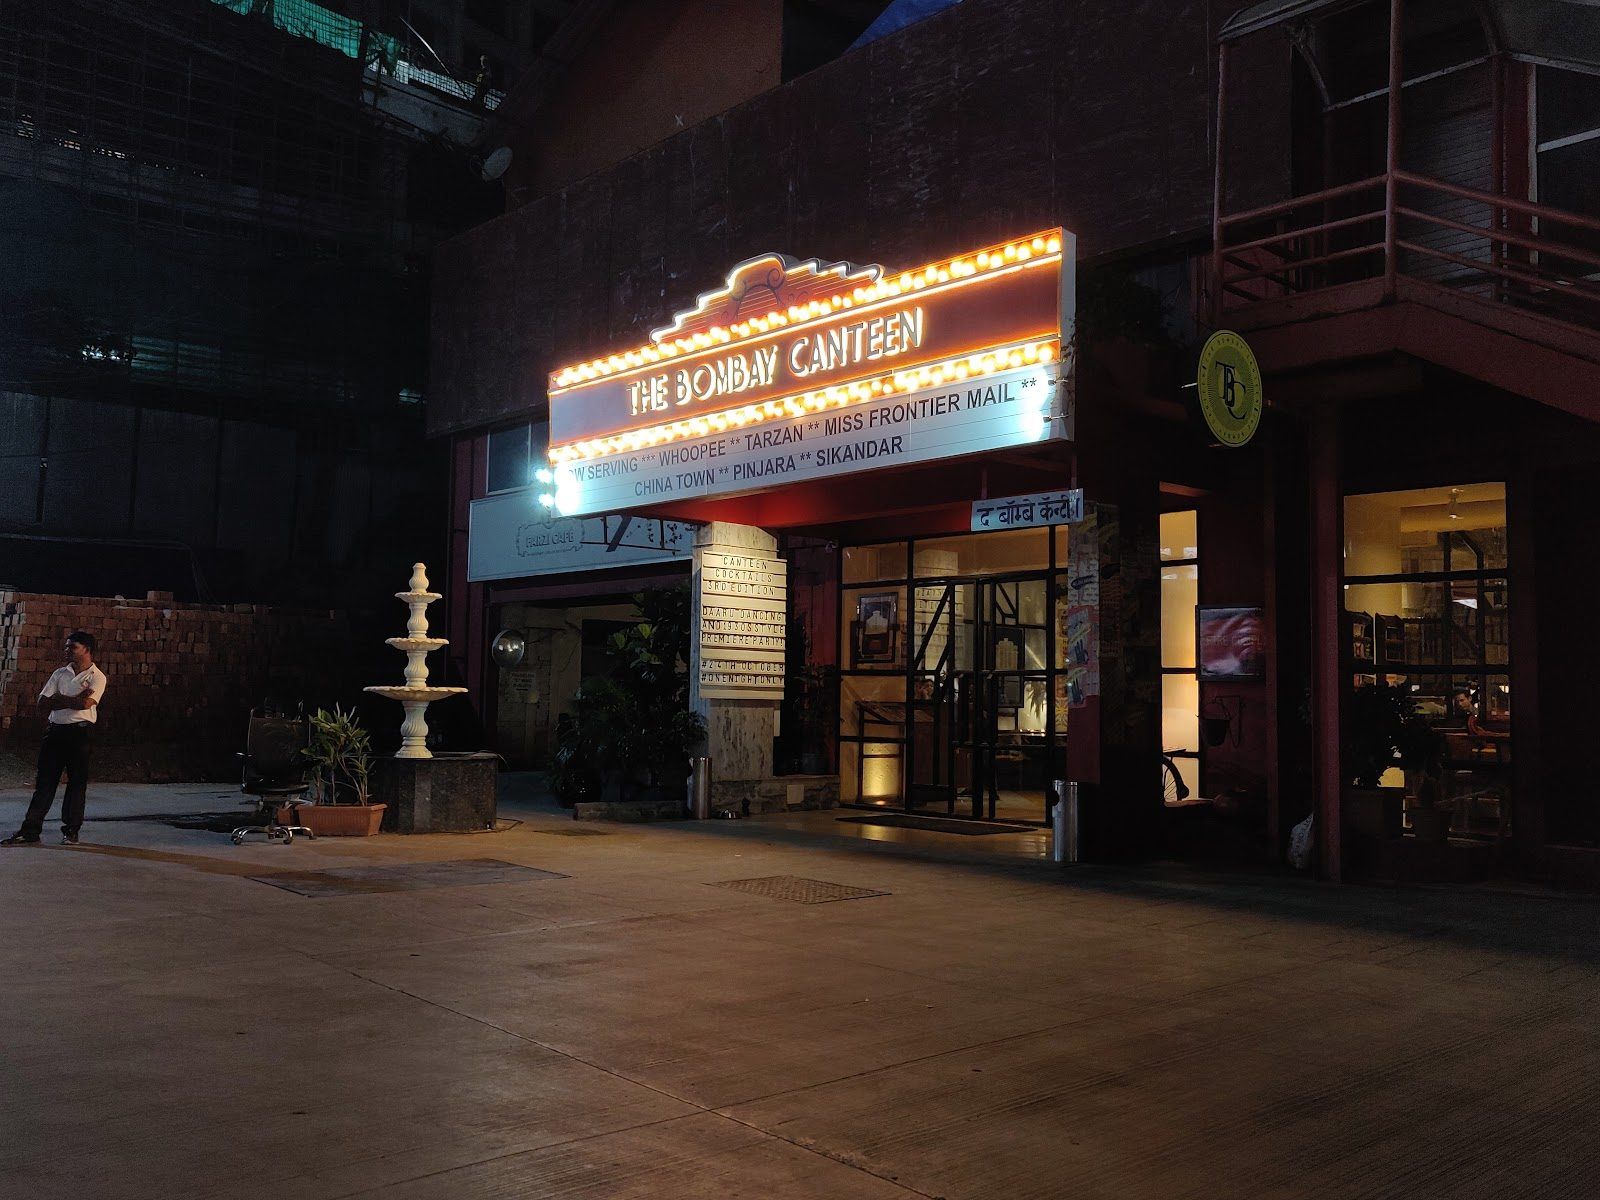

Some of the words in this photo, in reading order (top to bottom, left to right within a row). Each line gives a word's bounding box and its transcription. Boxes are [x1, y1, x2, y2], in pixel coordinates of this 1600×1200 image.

[626, 373, 669, 416] THE
[675, 345, 778, 406] BOMBAY
[788, 306, 923, 378] CANTEEN
[587, 457, 638, 480] SERVING
[659, 440, 726, 467] WHOOPEE
[744, 424, 803, 451] TARZAN
[824, 413, 864, 437] MISS
[869, 393, 960, 428] FRONTIER
[967, 383, 1015, 409] MAIL
[634, 477, 673, 496] CHINA
[676, 468, 715, 489] TOWN
[733, 455, 796, 480] PINJARA
[816, 435, 903, 467] SIKANDAR
[526, 534, 550, 548] FARZI
[723, 556, 768, 570] CANTEEN
[715, 568, 773, 583] COCKTAILS
[708, 581, 727, 591] 3RD
[730, 583, 775, 595] EDITION
[740, 609, 782, 622] DANCING
[701, 632, 749, 645] PREMIERE
